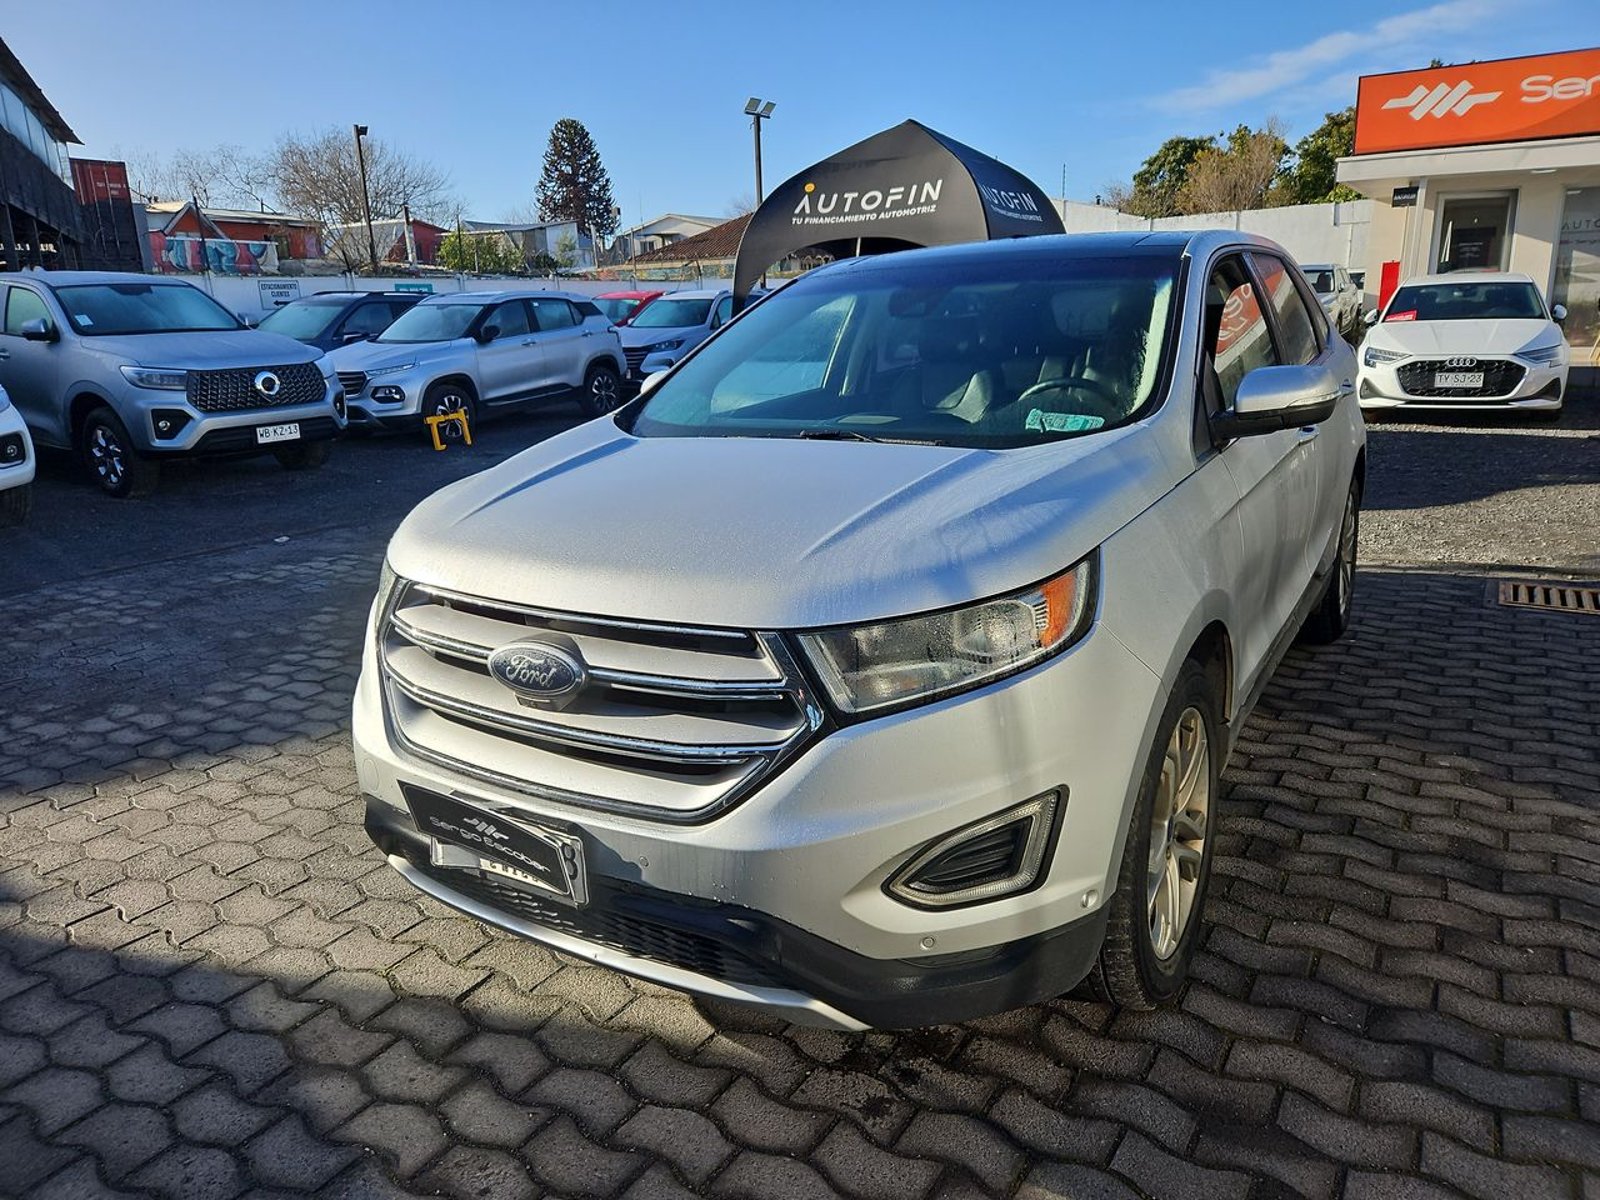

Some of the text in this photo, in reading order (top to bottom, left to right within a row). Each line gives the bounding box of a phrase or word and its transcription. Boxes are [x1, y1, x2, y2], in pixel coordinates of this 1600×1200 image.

[794, 179, 943, 215] AUTOFIN
[791, 204, 936, 225] TU FINANCIAMIENTO AUTOMOTRIZ
[505, 654, 557, 688] Ford
